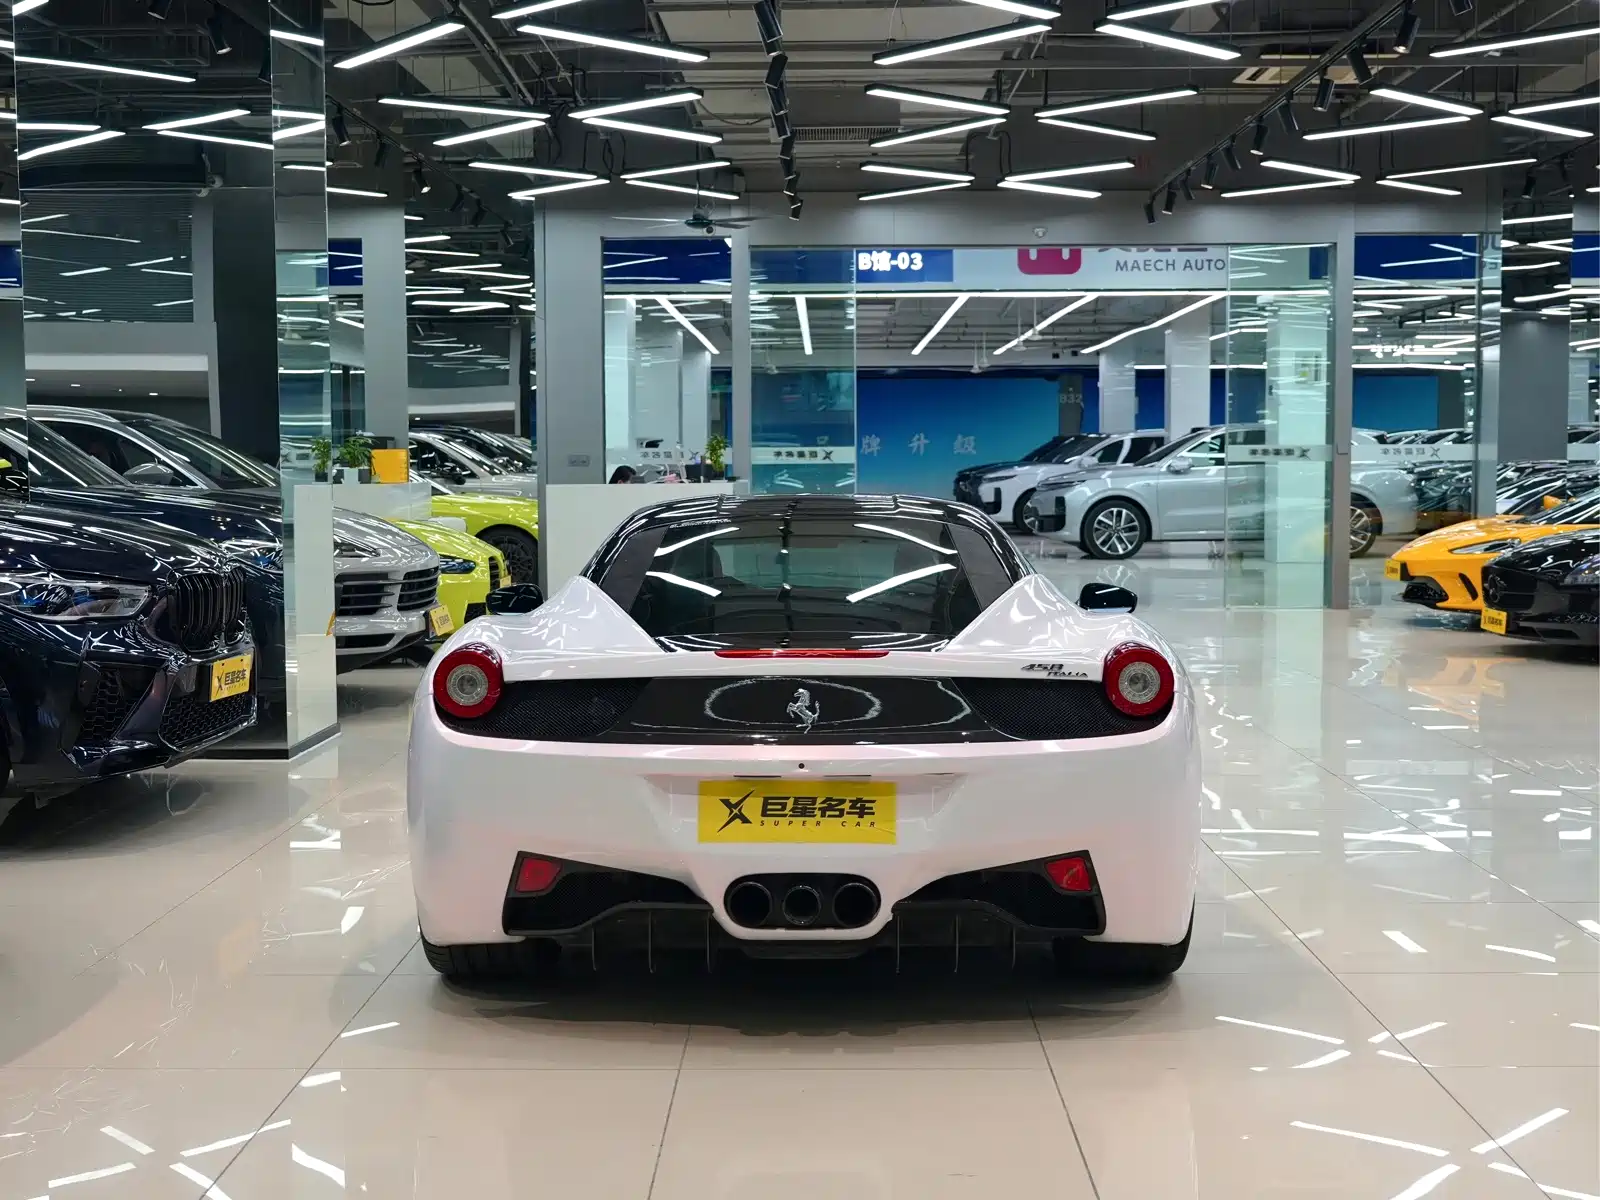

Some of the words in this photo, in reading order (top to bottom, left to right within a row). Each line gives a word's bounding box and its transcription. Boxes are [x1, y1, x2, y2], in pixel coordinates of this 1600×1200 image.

[1115, 259, 1176, 272] MAECH
[1183, 258, 1226, 271] AUTO
[1021, 663, 1064, 672] 458
[760, 796, 876, 818] 巨星名车
[760, 820, 822, 828] SUPER
[841, 820, 877, 828] CAR
